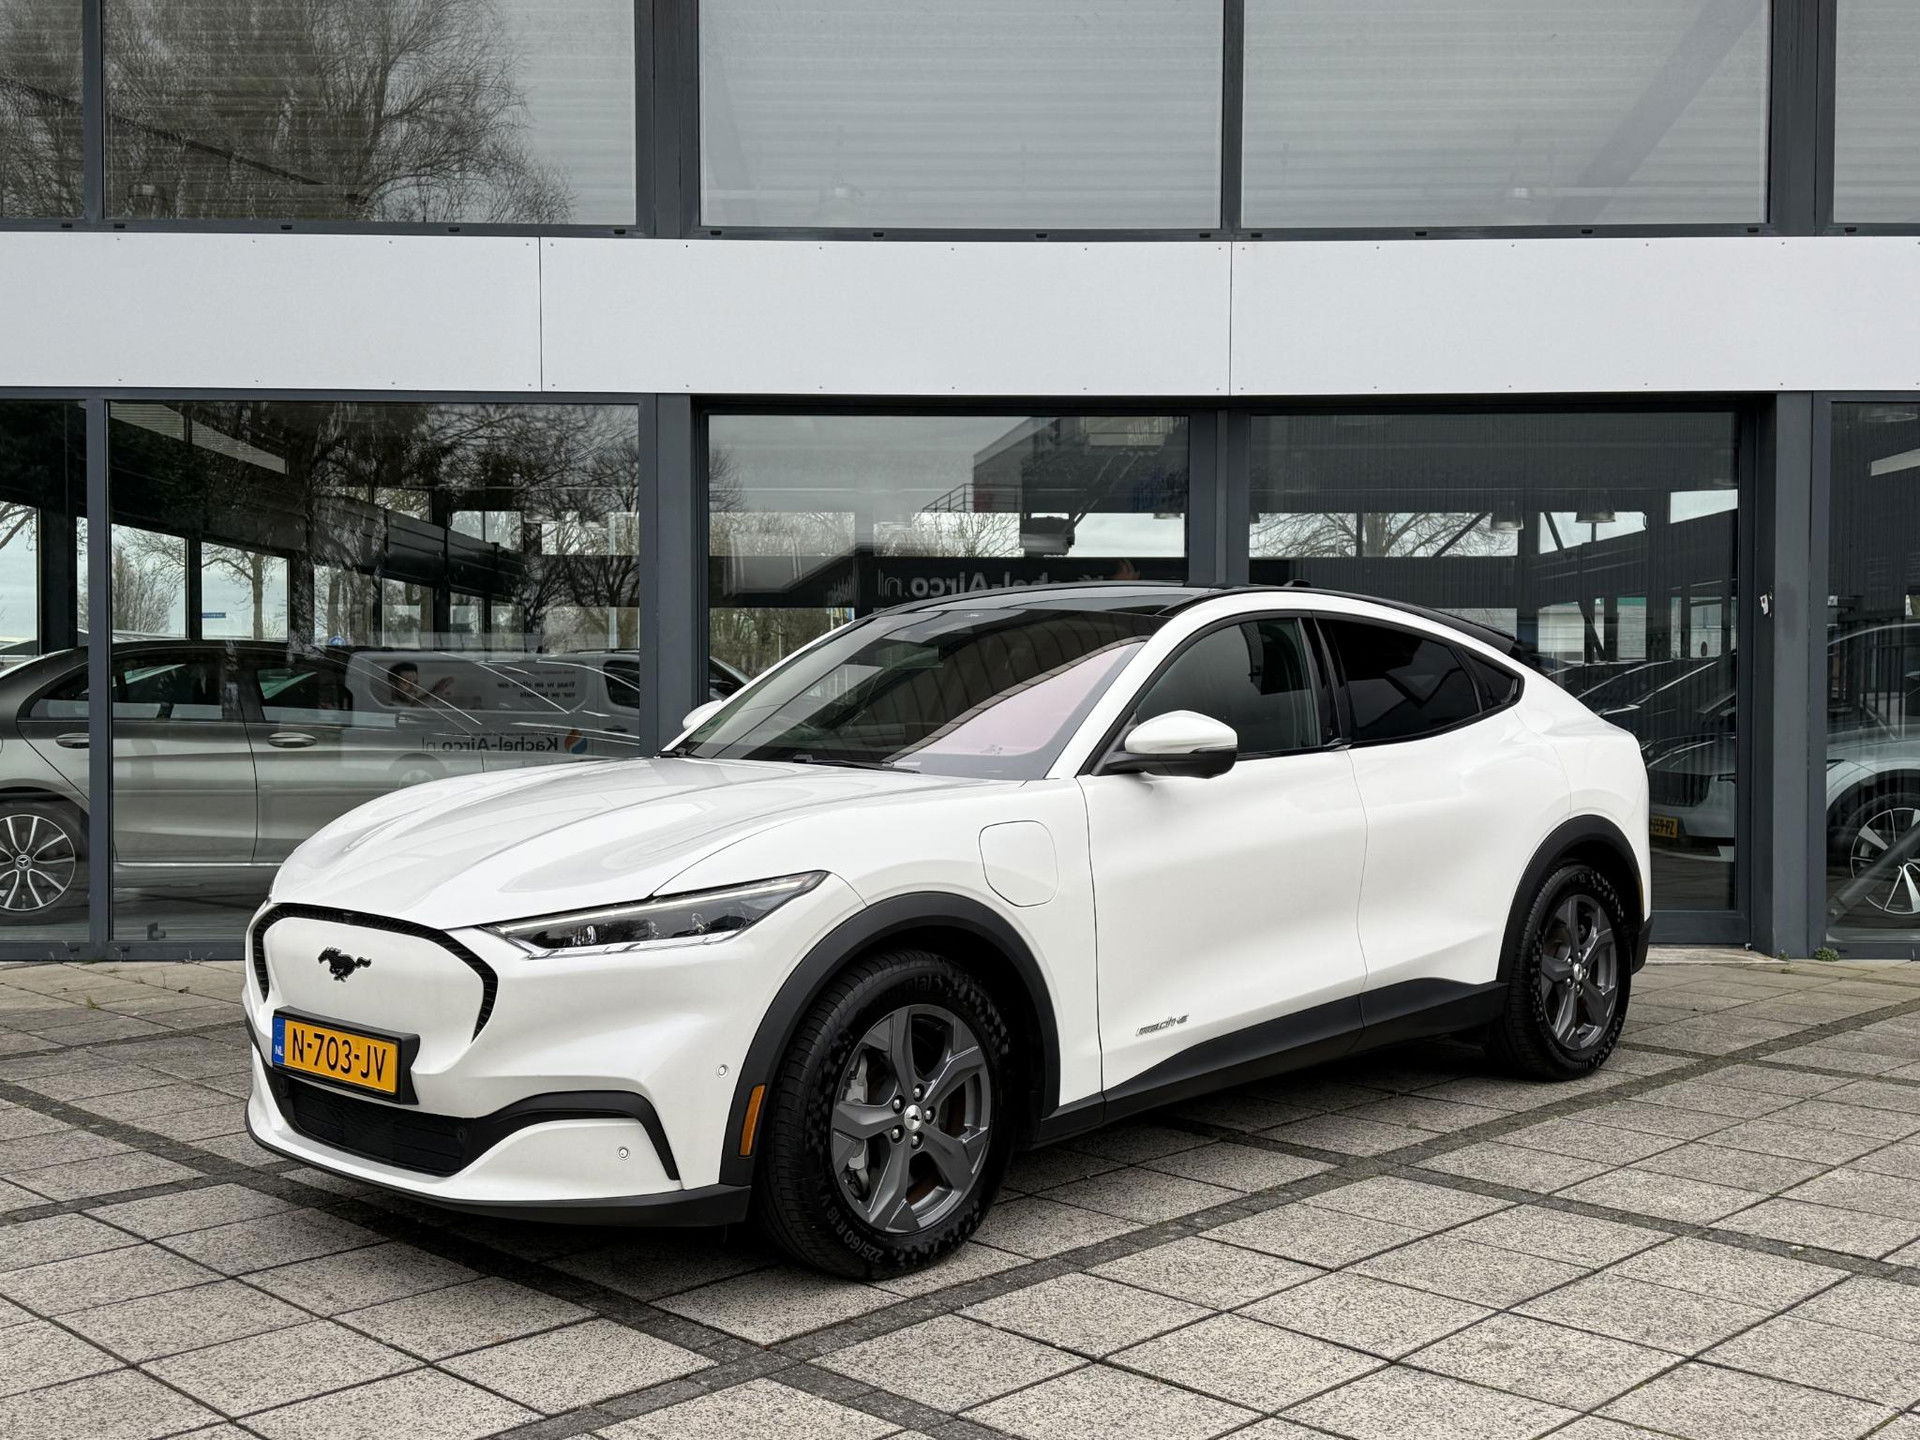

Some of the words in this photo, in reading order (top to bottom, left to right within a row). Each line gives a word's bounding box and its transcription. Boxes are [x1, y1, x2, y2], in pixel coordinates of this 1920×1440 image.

[274, 1045, 284, 1056] NL
[292, 1027, 386, 1082] N-703-JV
[843, 1229, 885, 1265] 225/60
